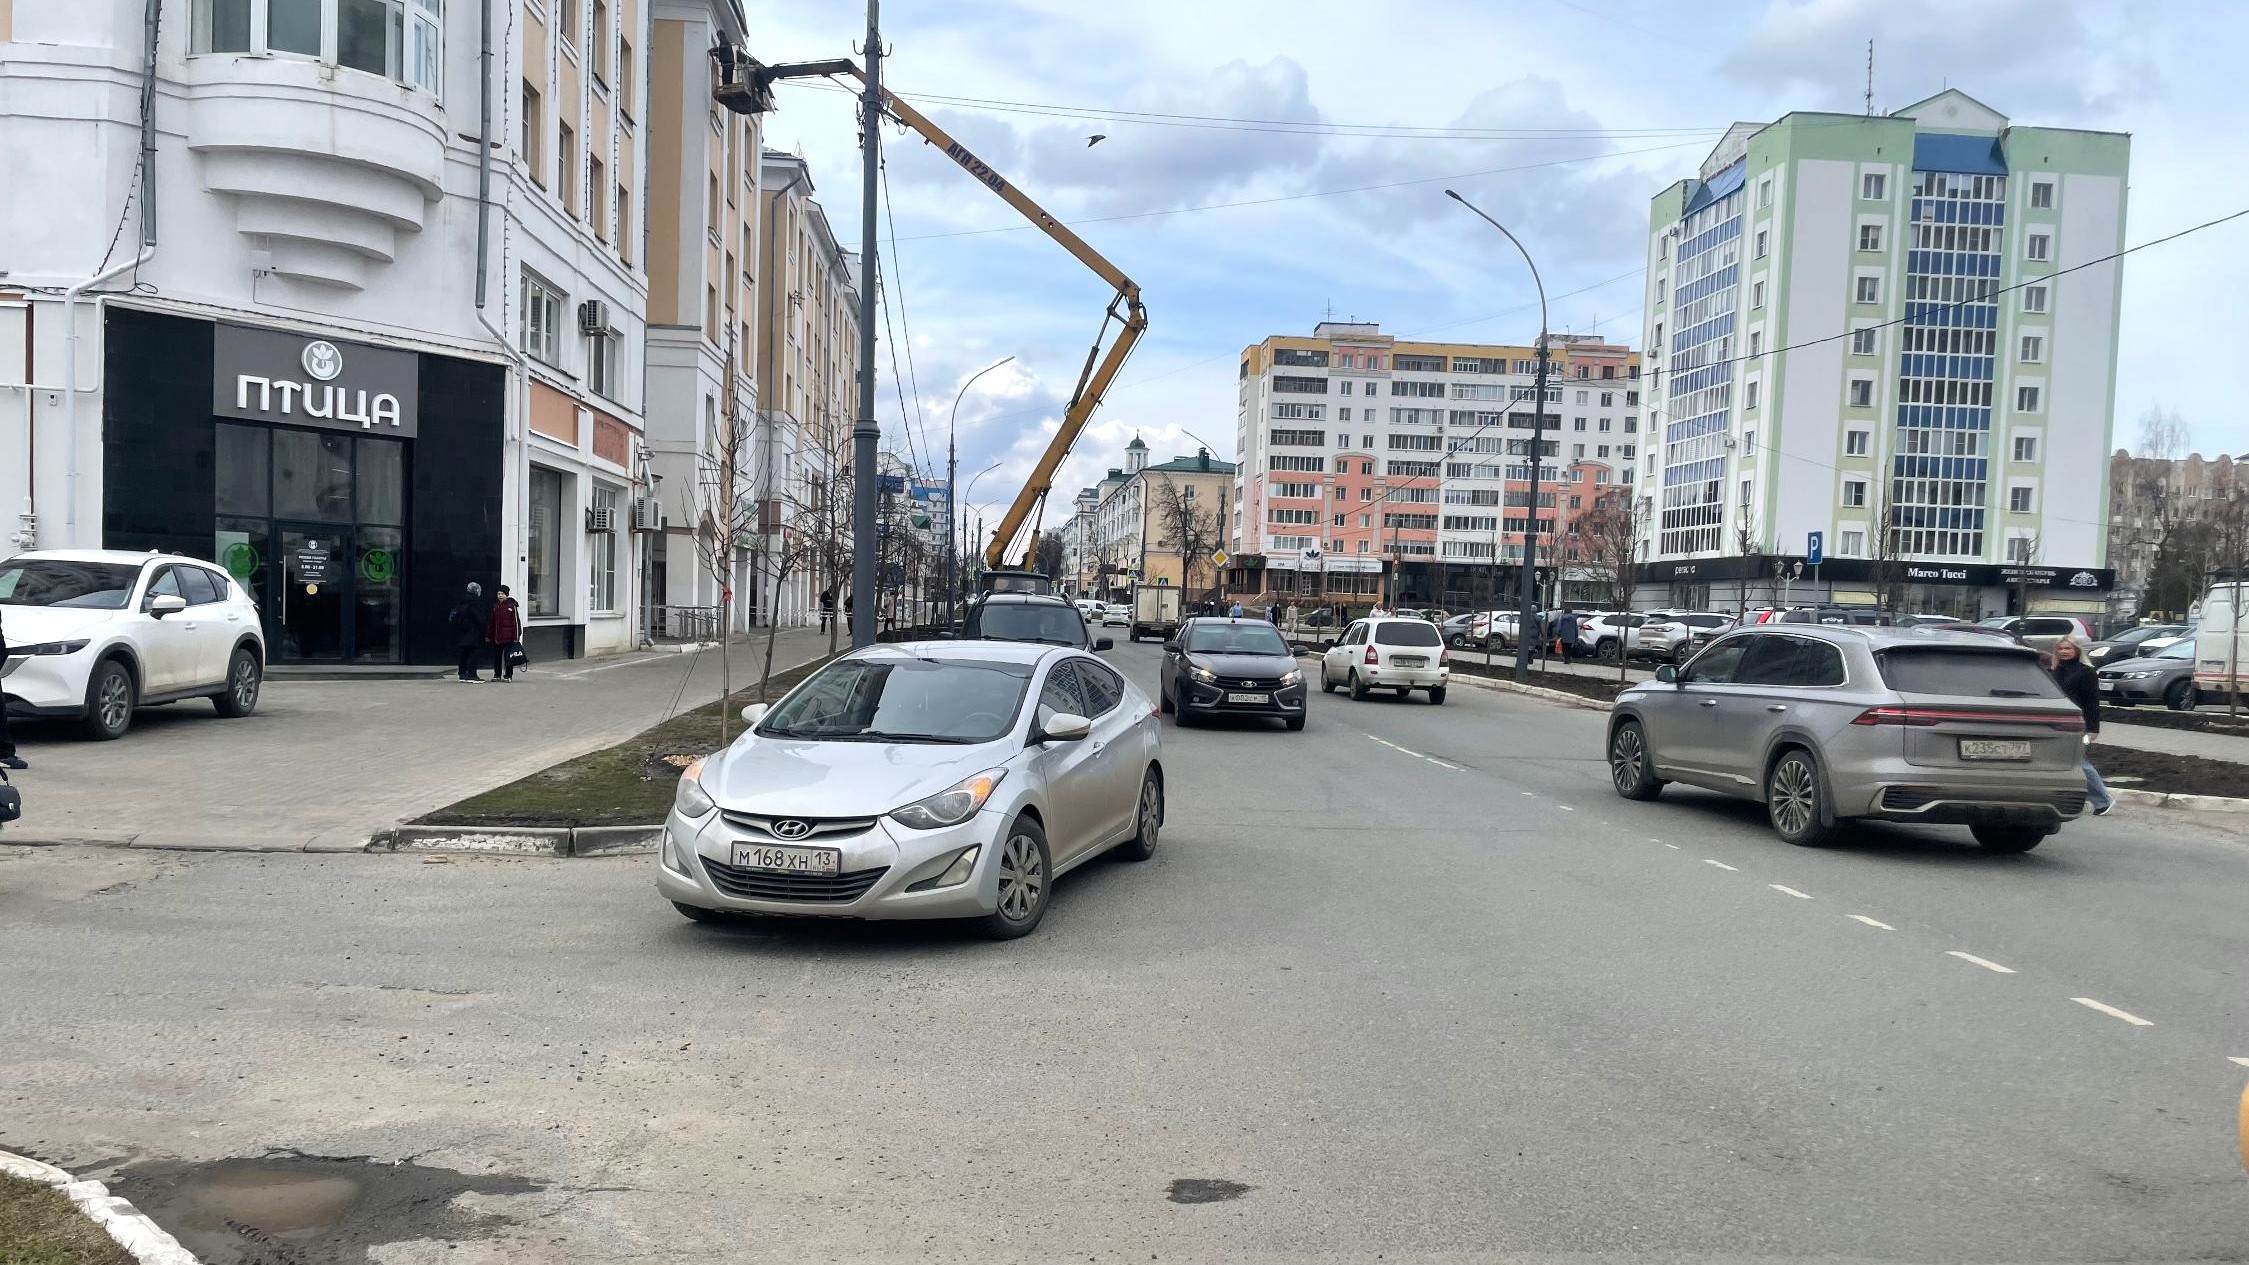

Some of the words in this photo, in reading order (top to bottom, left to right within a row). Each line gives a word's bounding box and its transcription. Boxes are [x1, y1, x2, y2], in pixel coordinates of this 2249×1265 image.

[236, 374, 400, 429] ПТИЦА
[1811, 535, 1819, 560] P
[1907, 567, 1939, 578] Marco
[1940, 569, 1967, 579] Tucci
[739, 848, 809, 870] М168ХН
[814, 851, 832, 866] 13
